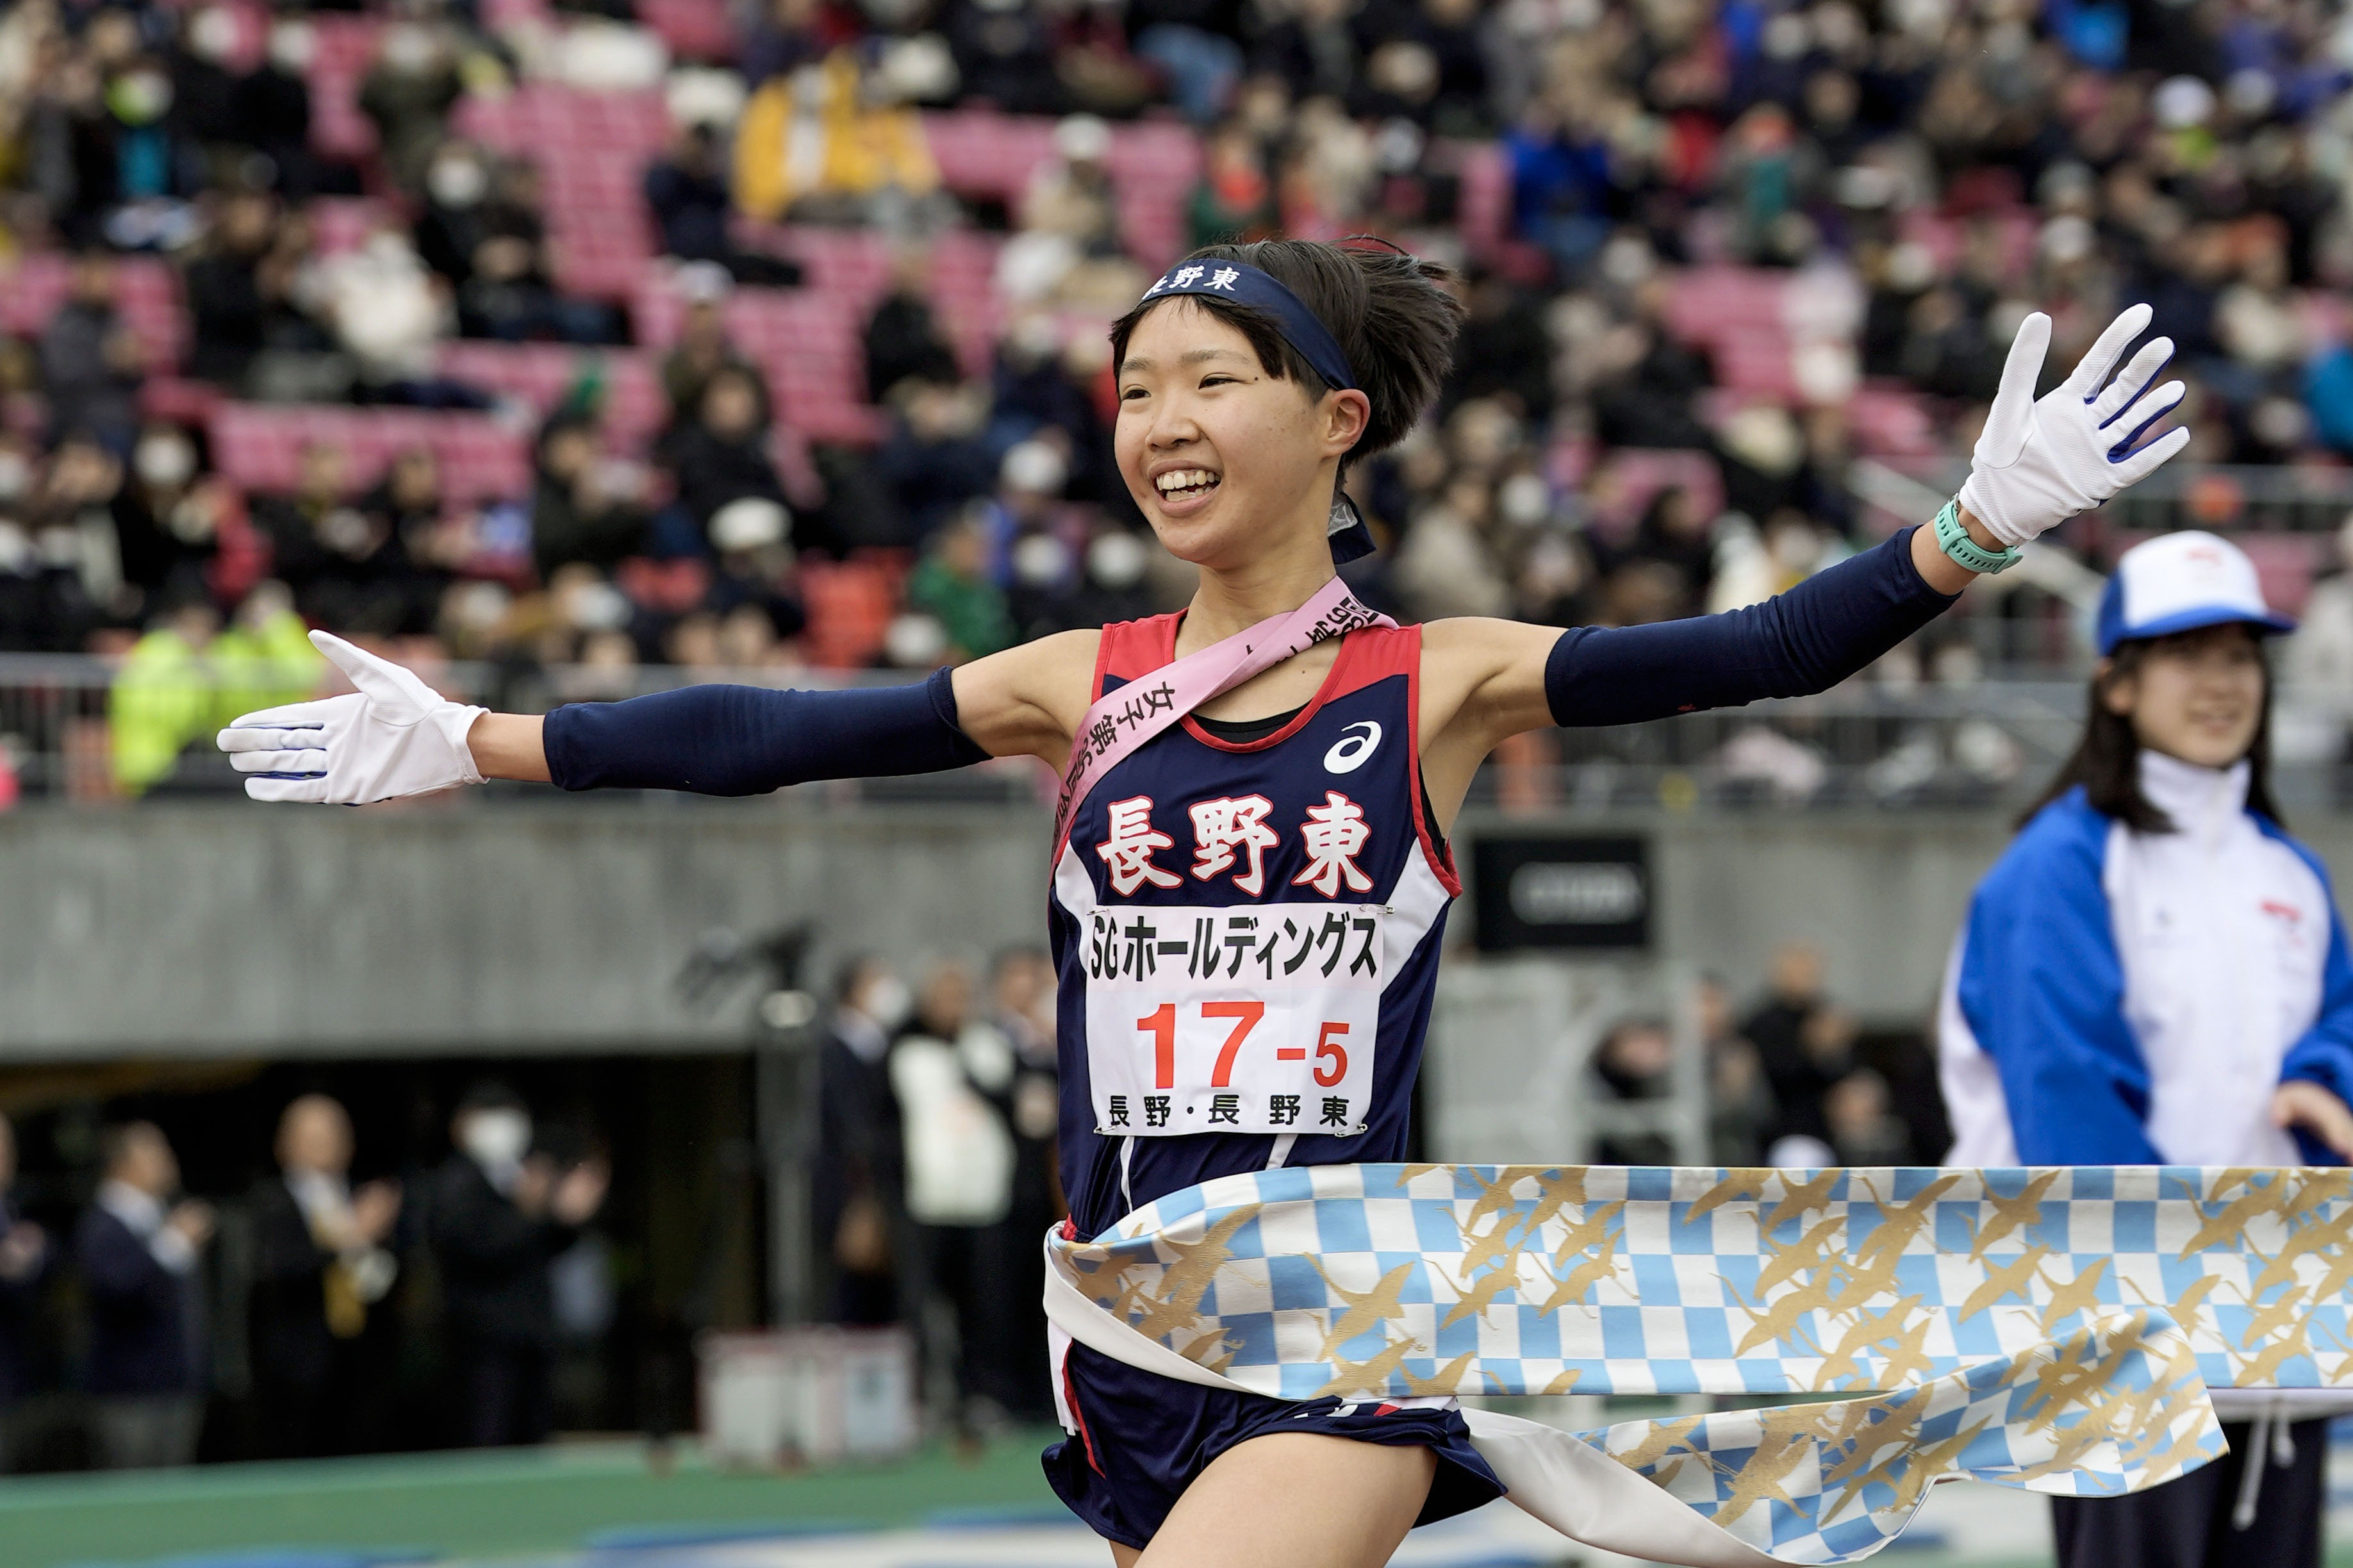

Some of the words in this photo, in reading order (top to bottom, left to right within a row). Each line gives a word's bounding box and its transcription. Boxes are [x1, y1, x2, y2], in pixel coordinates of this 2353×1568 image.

[1096, 791, 1374, 898] 長野東
[1091, 911, 1378, 982] SGホールディングス
